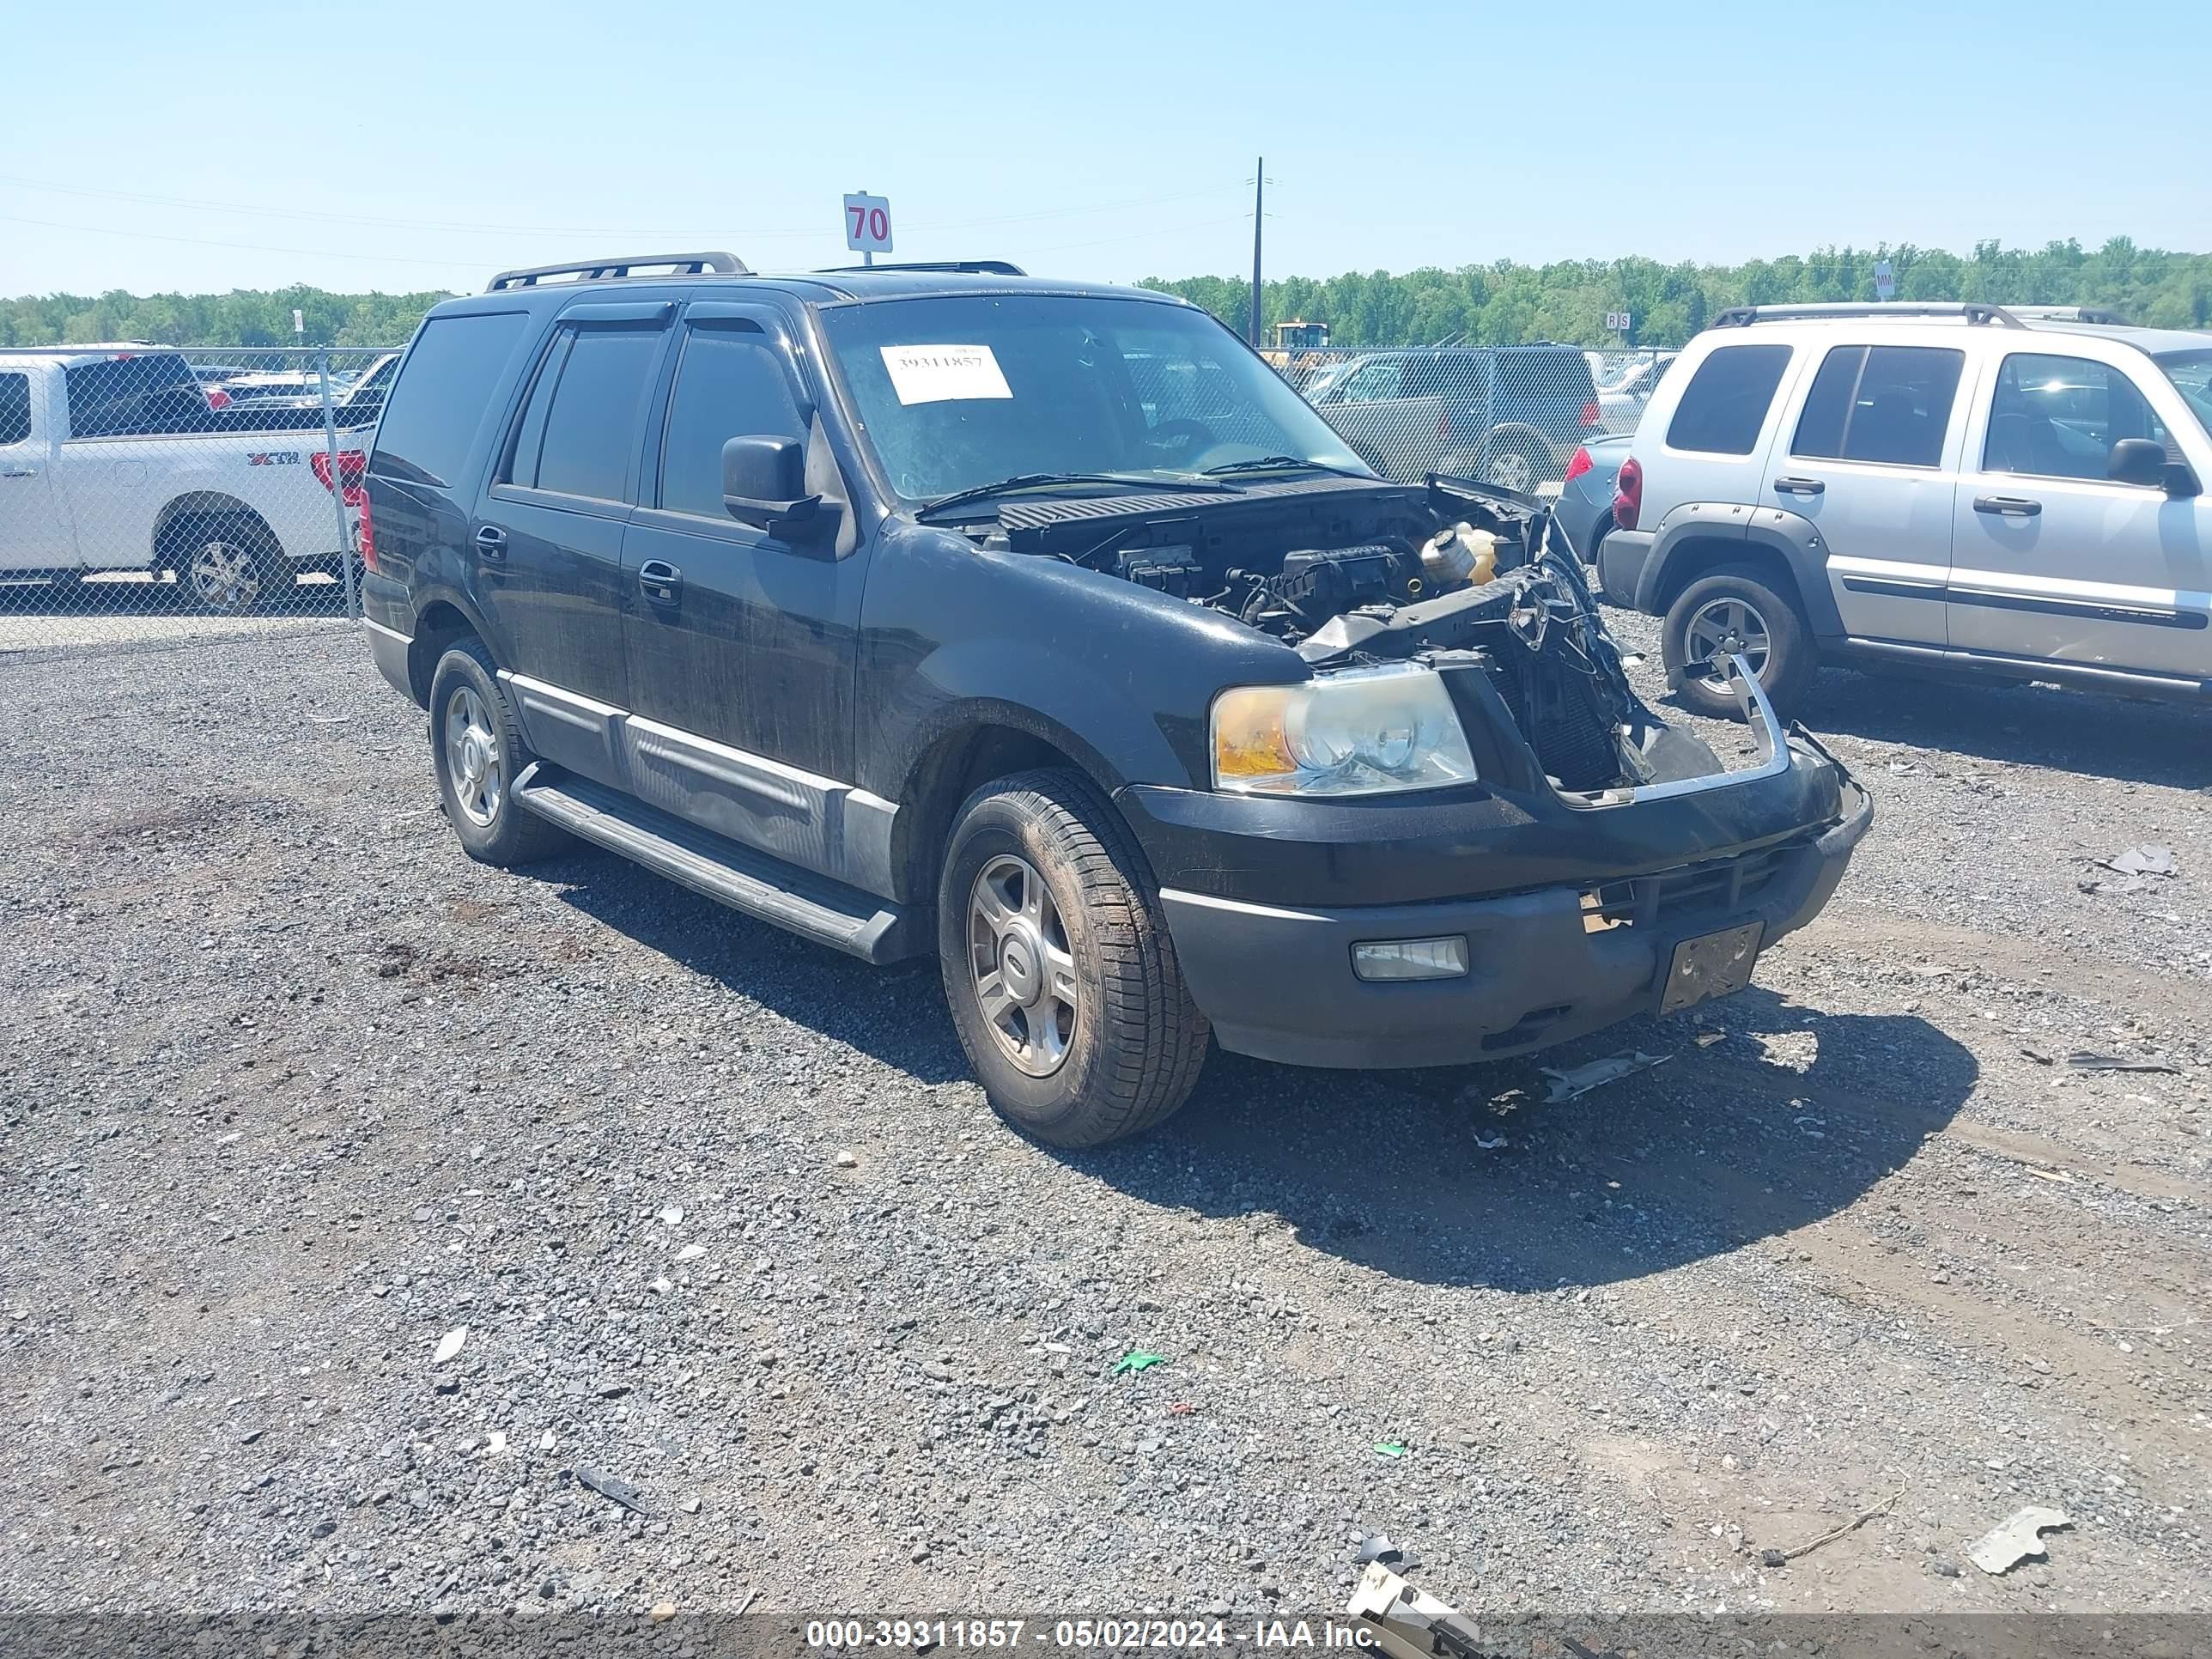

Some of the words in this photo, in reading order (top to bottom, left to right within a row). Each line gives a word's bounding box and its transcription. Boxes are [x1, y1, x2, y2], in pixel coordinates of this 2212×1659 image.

[848, 206, 888, 240] 70
[1609, 315, 1615, 326] R
[1621, 315, 1628, 326] S
[898, 356, 982, 370] 39311857
